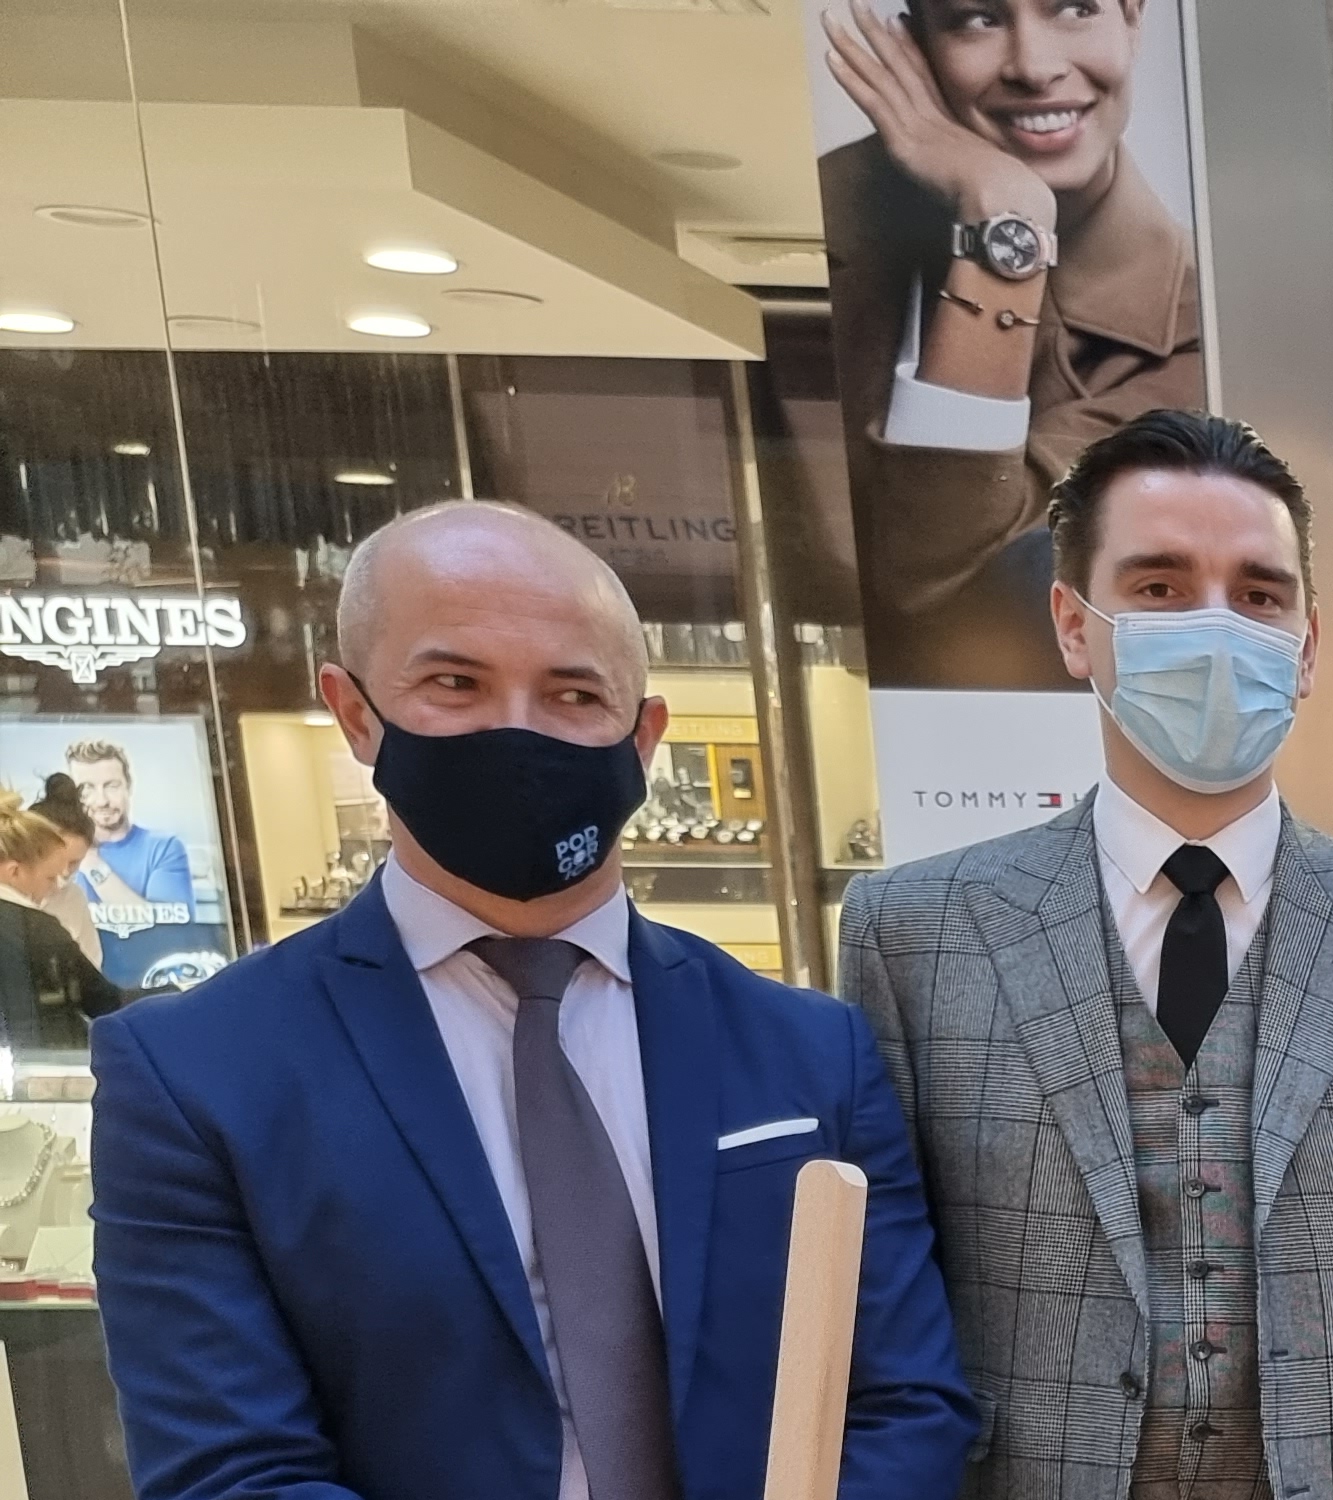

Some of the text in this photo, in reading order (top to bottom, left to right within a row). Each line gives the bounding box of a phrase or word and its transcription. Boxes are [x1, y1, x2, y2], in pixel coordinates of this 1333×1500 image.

[553, 514, 738, 541] REITLING
[0, 597, 246, 648] NGINES
[913, 791, 1027, 808] TOMMY
[555, 825, 599, 860] POD
[88, 902, 190, 924] NGINES
